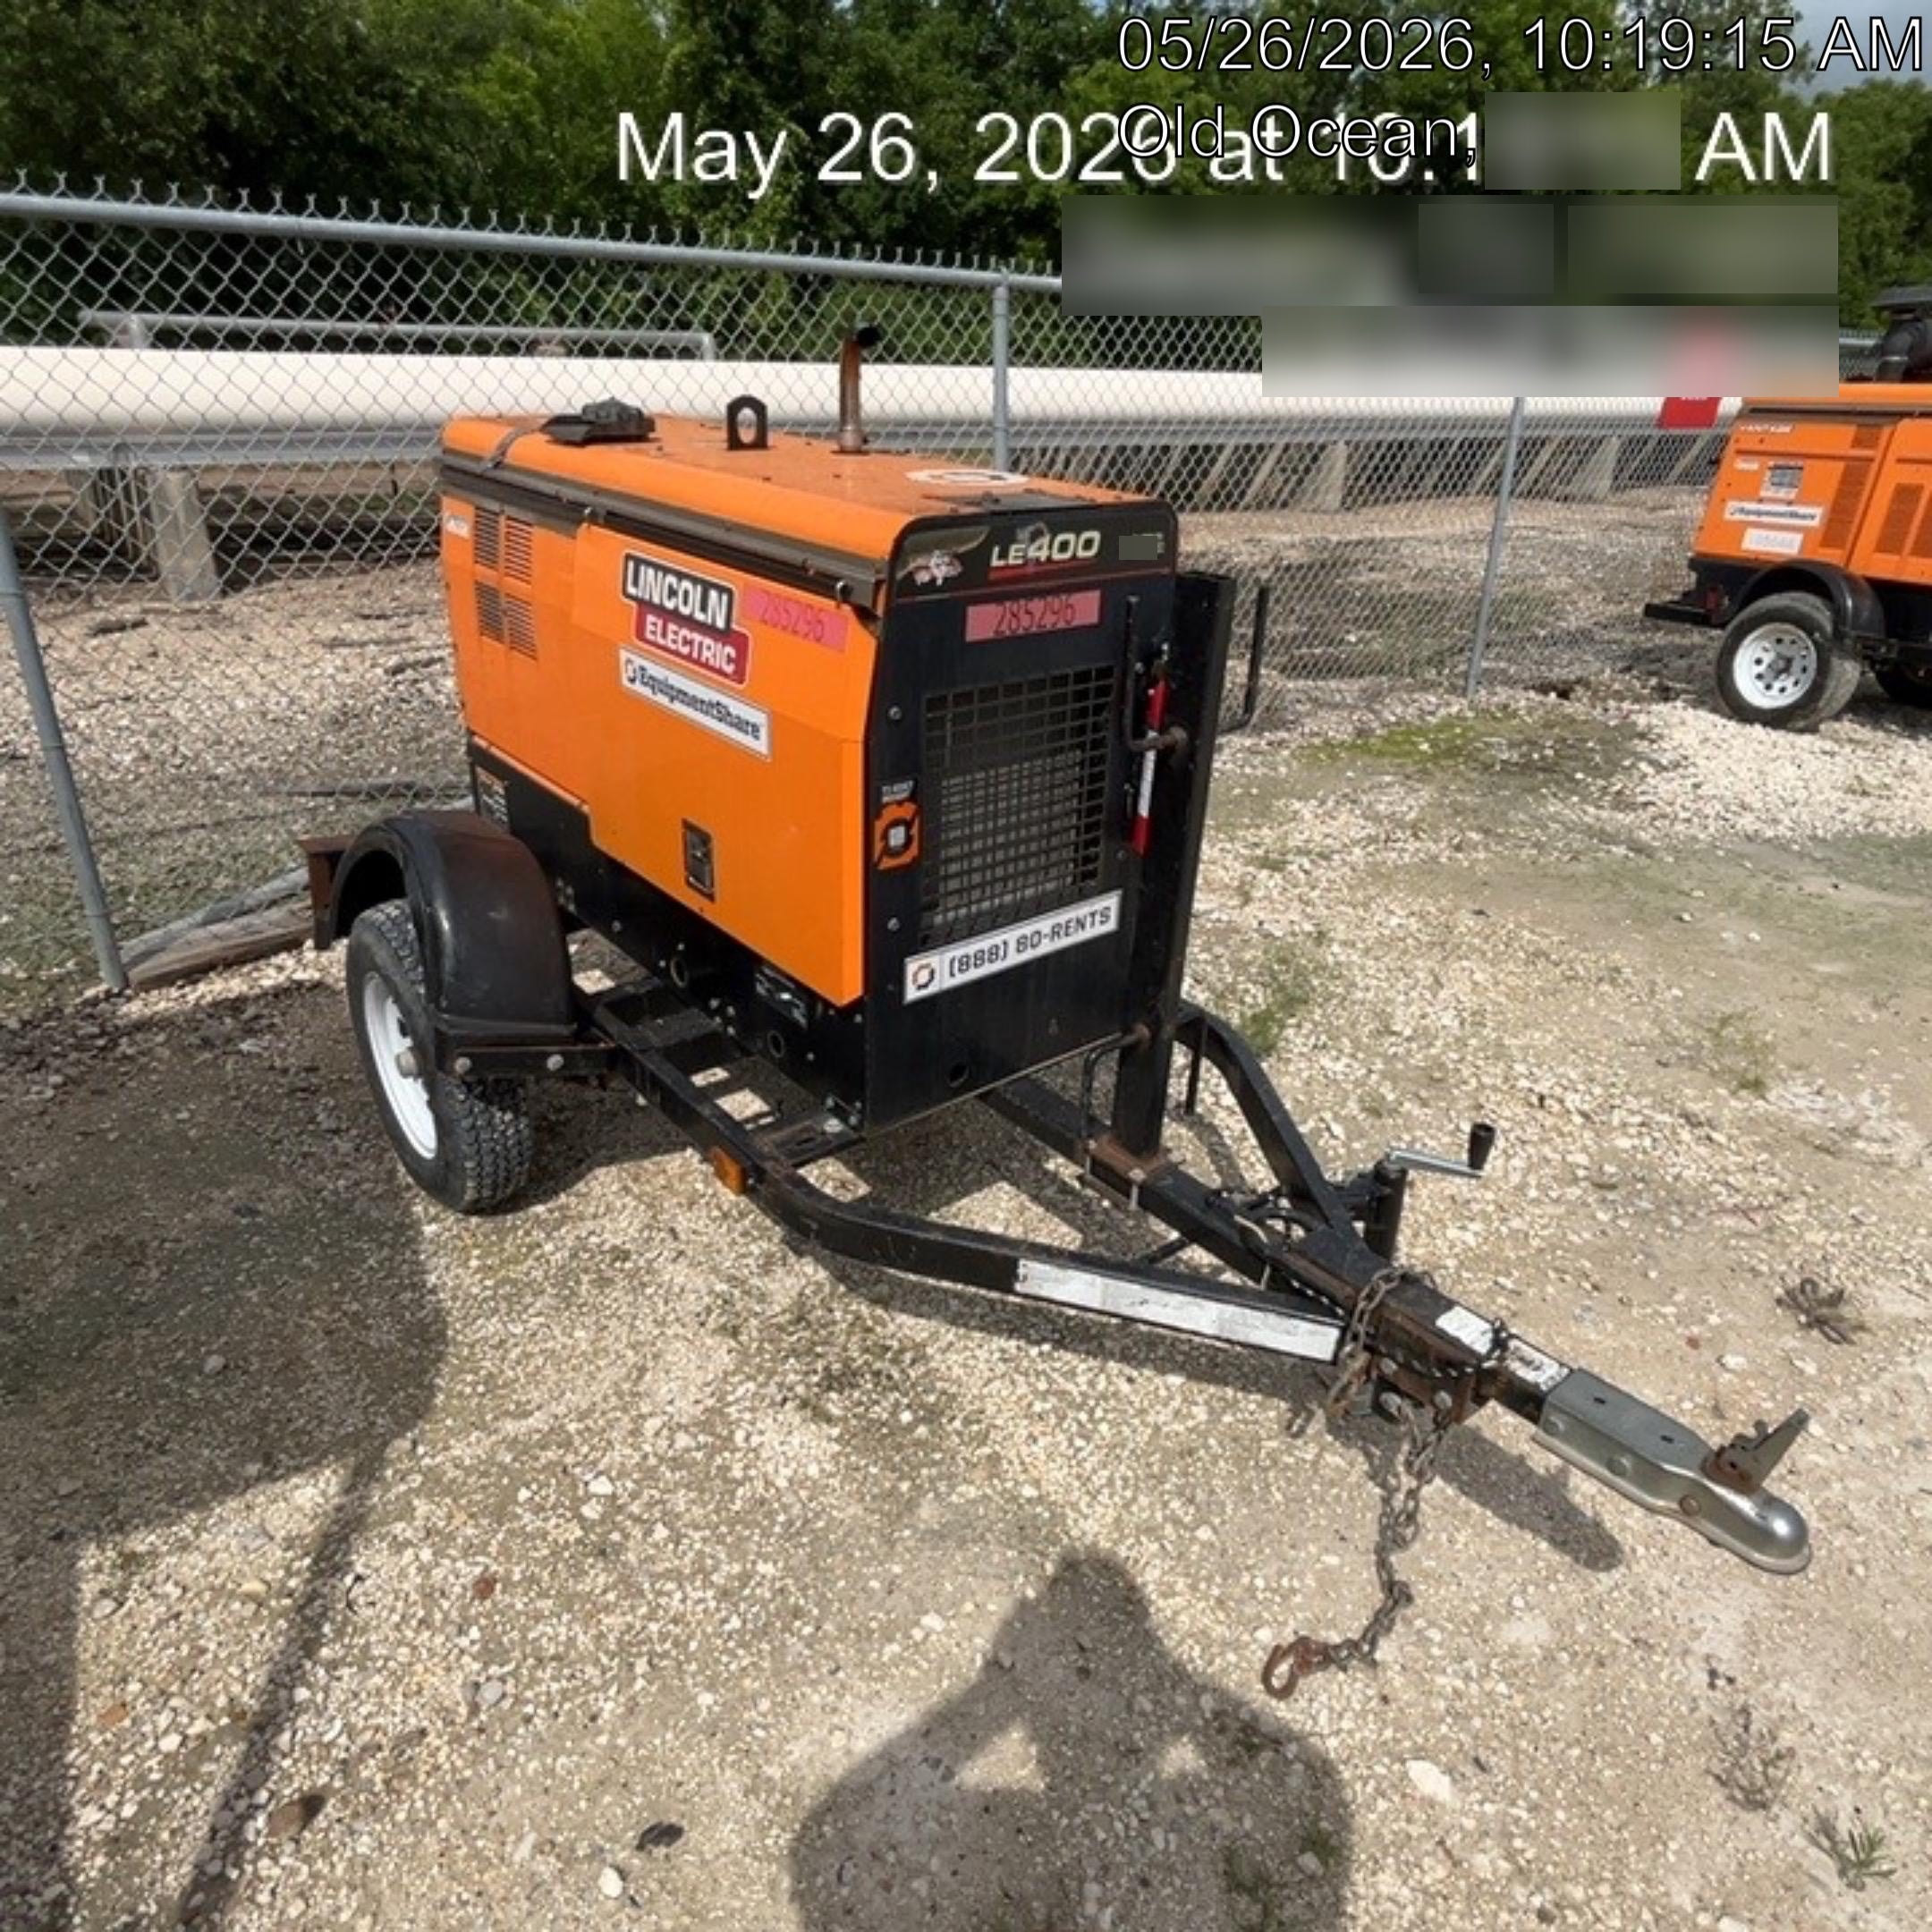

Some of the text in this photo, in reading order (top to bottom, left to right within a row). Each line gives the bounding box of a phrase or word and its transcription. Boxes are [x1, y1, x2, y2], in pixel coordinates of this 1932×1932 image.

[990, 530, 1101, 567] LE400
[627, 559, 728, 631] LINCOLN
[993, 596, 1077, 637] 285296
[645, 614, 737, 675] ELECTRIC
[638, 664, 760, 741] EquipmentShare
[949, 943, 1009, 978] (888)
